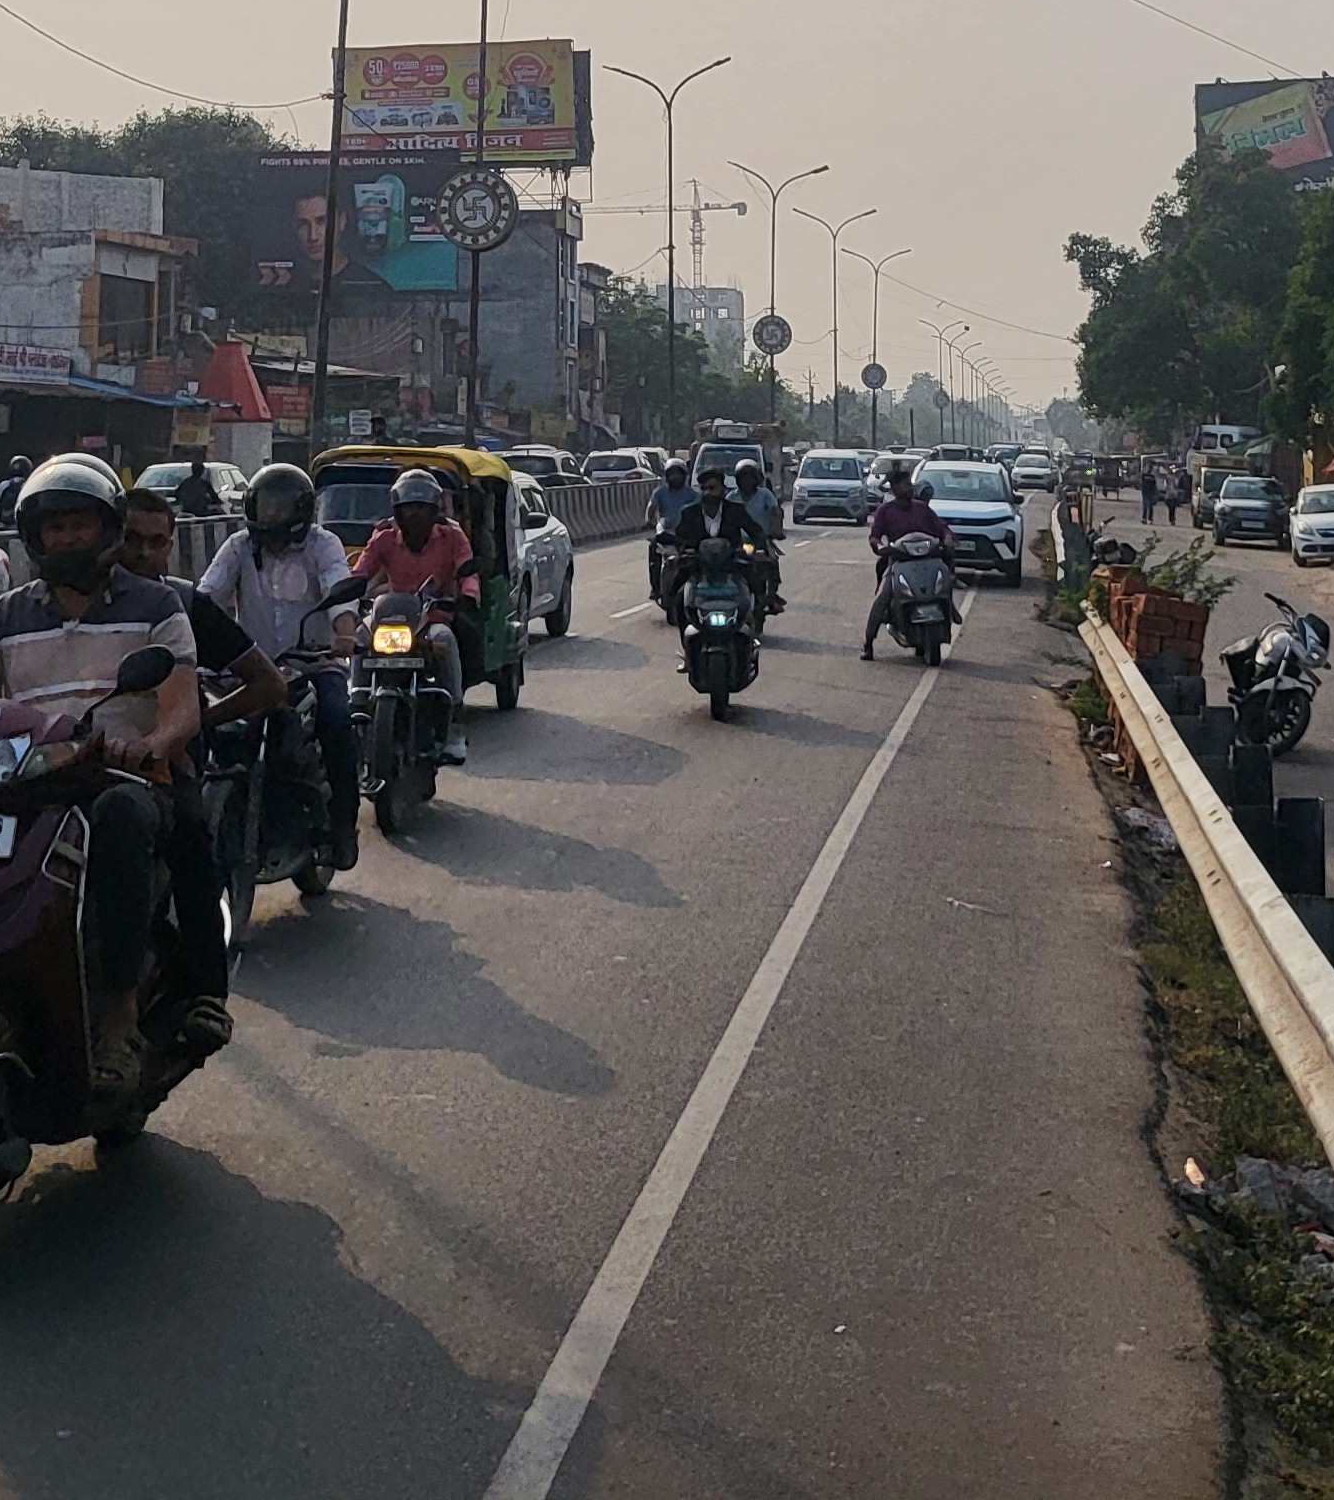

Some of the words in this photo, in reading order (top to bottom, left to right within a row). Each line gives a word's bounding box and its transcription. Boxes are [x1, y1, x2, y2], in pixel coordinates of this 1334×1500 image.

[261, 157, 291, 167] FIGHTS
[353, 157, 386, 166] GENTLE
[388, 157, 402, 165] ON
